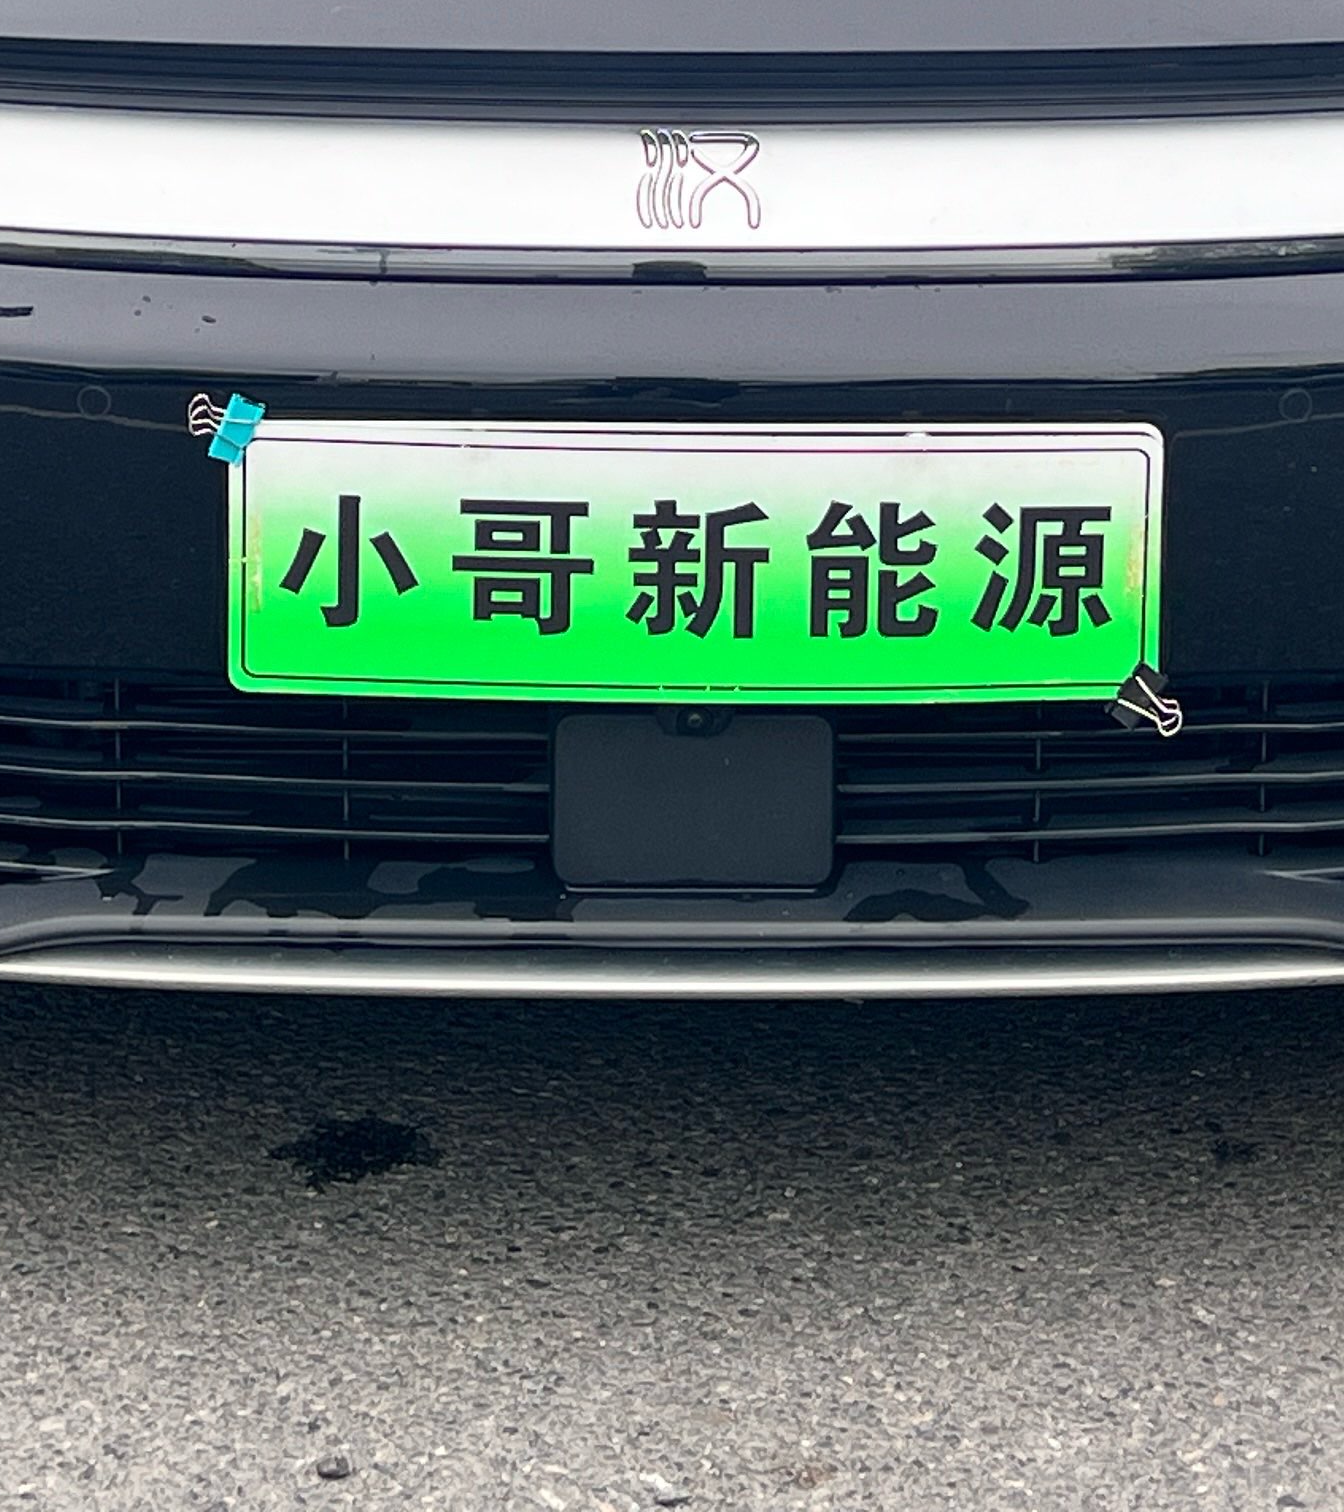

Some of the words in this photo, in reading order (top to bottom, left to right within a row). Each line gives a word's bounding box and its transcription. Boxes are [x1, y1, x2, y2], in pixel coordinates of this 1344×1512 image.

[279, 493, 1113, 639] 小哥新能源
